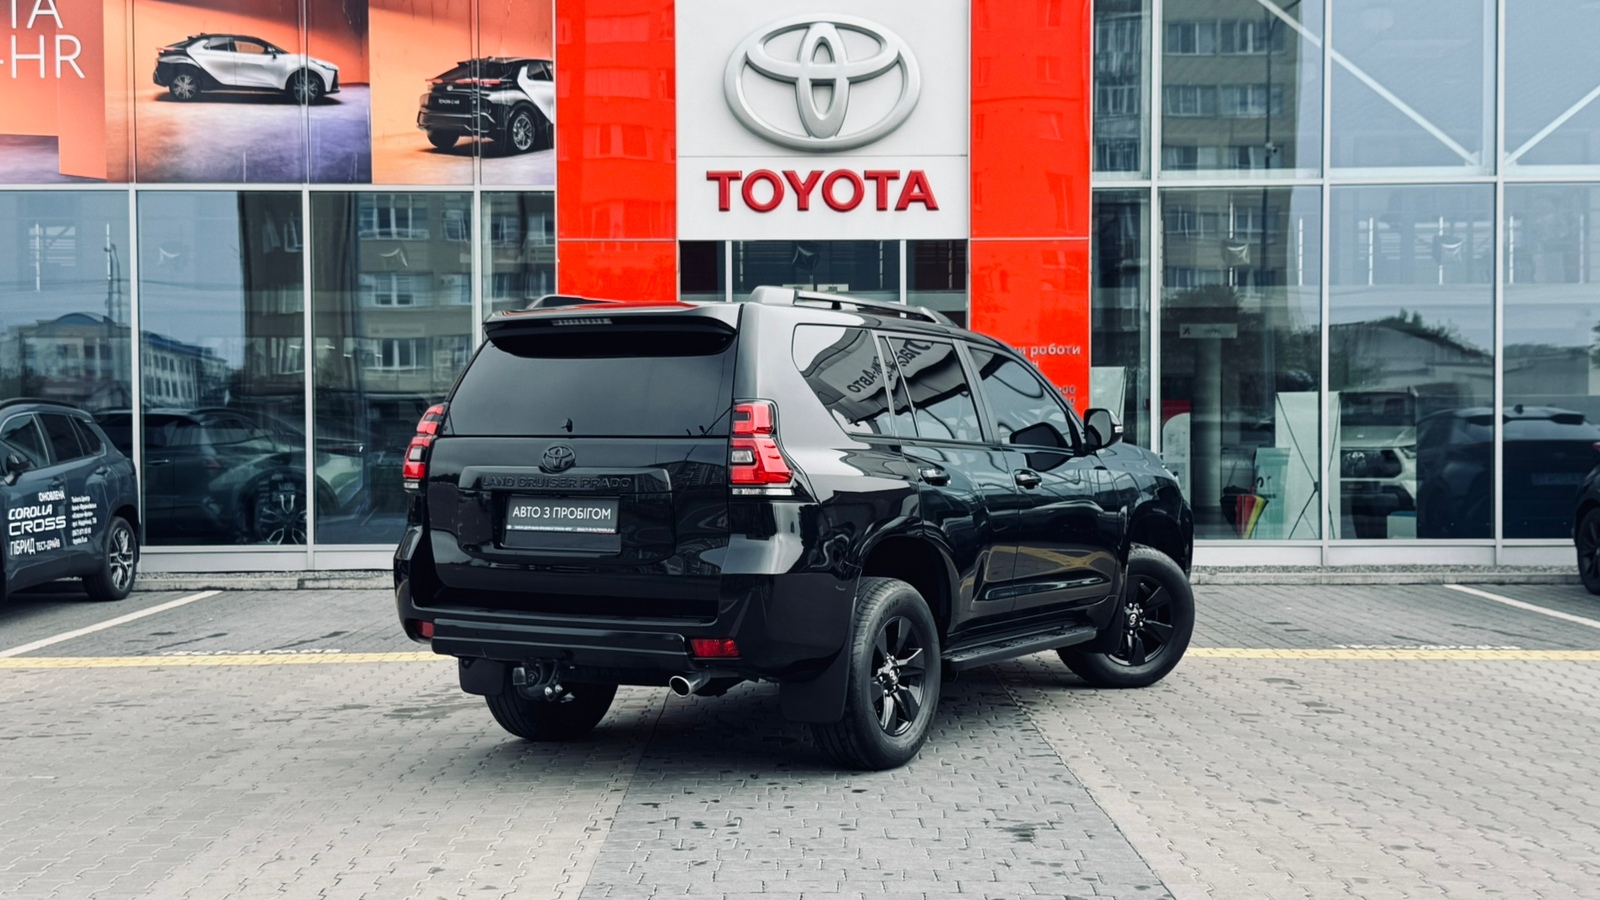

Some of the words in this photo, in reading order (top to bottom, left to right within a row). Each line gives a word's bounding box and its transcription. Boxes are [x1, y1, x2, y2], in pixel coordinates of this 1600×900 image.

[706, 168, 940, 213] TOYOTA
[1030, 343, 1081, 357] роботи
[481, 476, 515, 488] LAND
[518, 476, 578, 489] CRUISER
[581, 477, 632, 489] PRADO
[8, 503, 53, 520] COROLLA
[512, 506, 541, 518] АВТО
[552, 507, 612, 520] ПРОБІГОМ
[9, 515, 67, 536] CROSS
